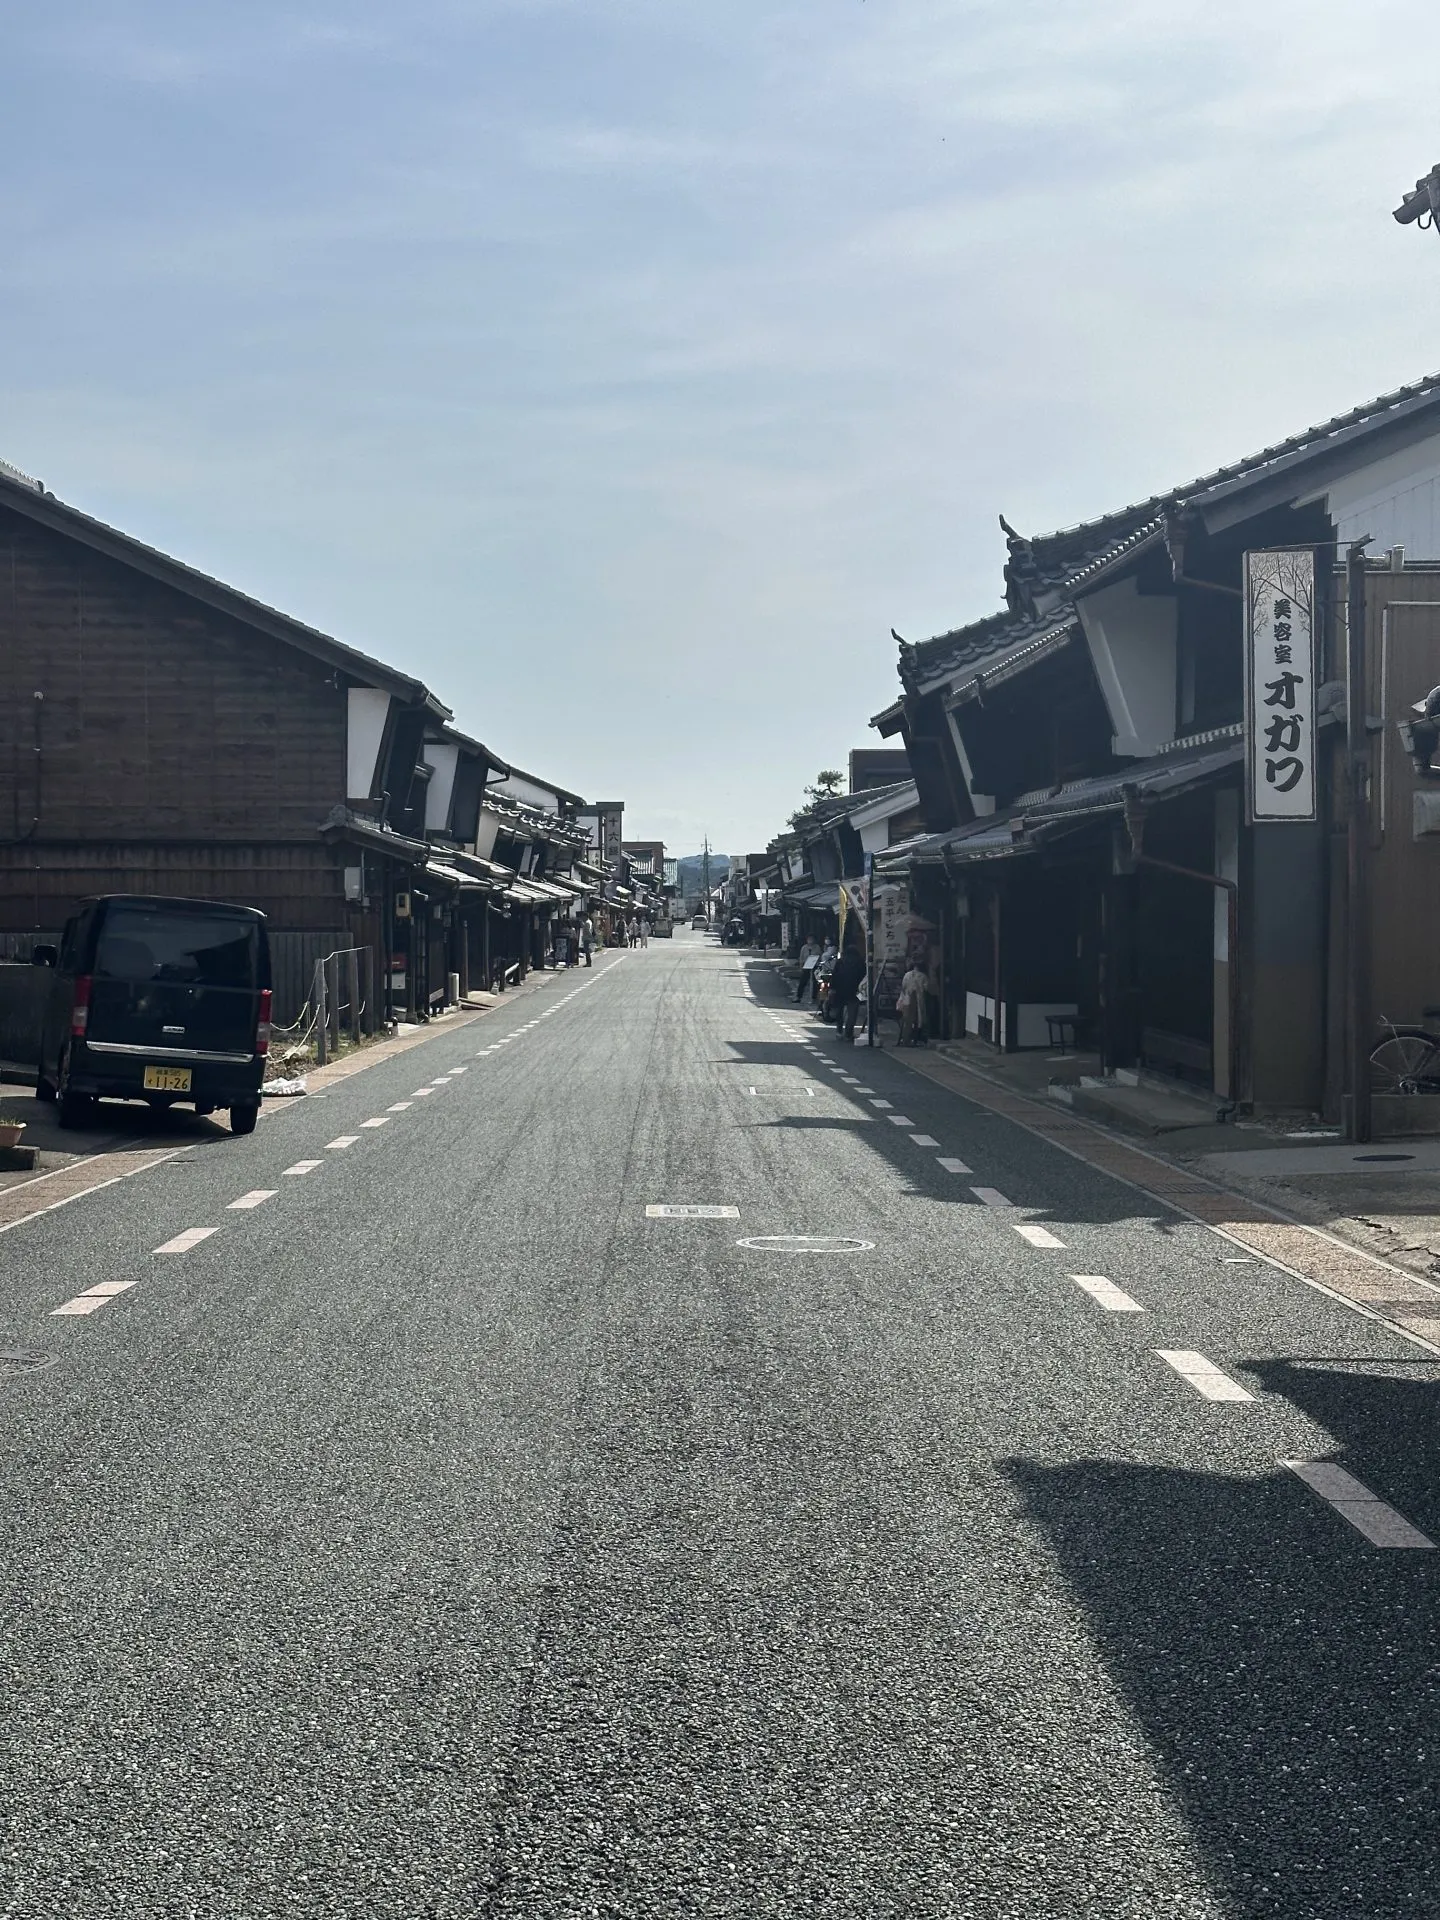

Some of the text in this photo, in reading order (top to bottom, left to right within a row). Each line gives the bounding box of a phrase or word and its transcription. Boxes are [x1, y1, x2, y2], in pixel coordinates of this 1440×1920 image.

[1273, 599, 1293, 665] 美容室
[1263, 671, 1305, 793] オガワ
